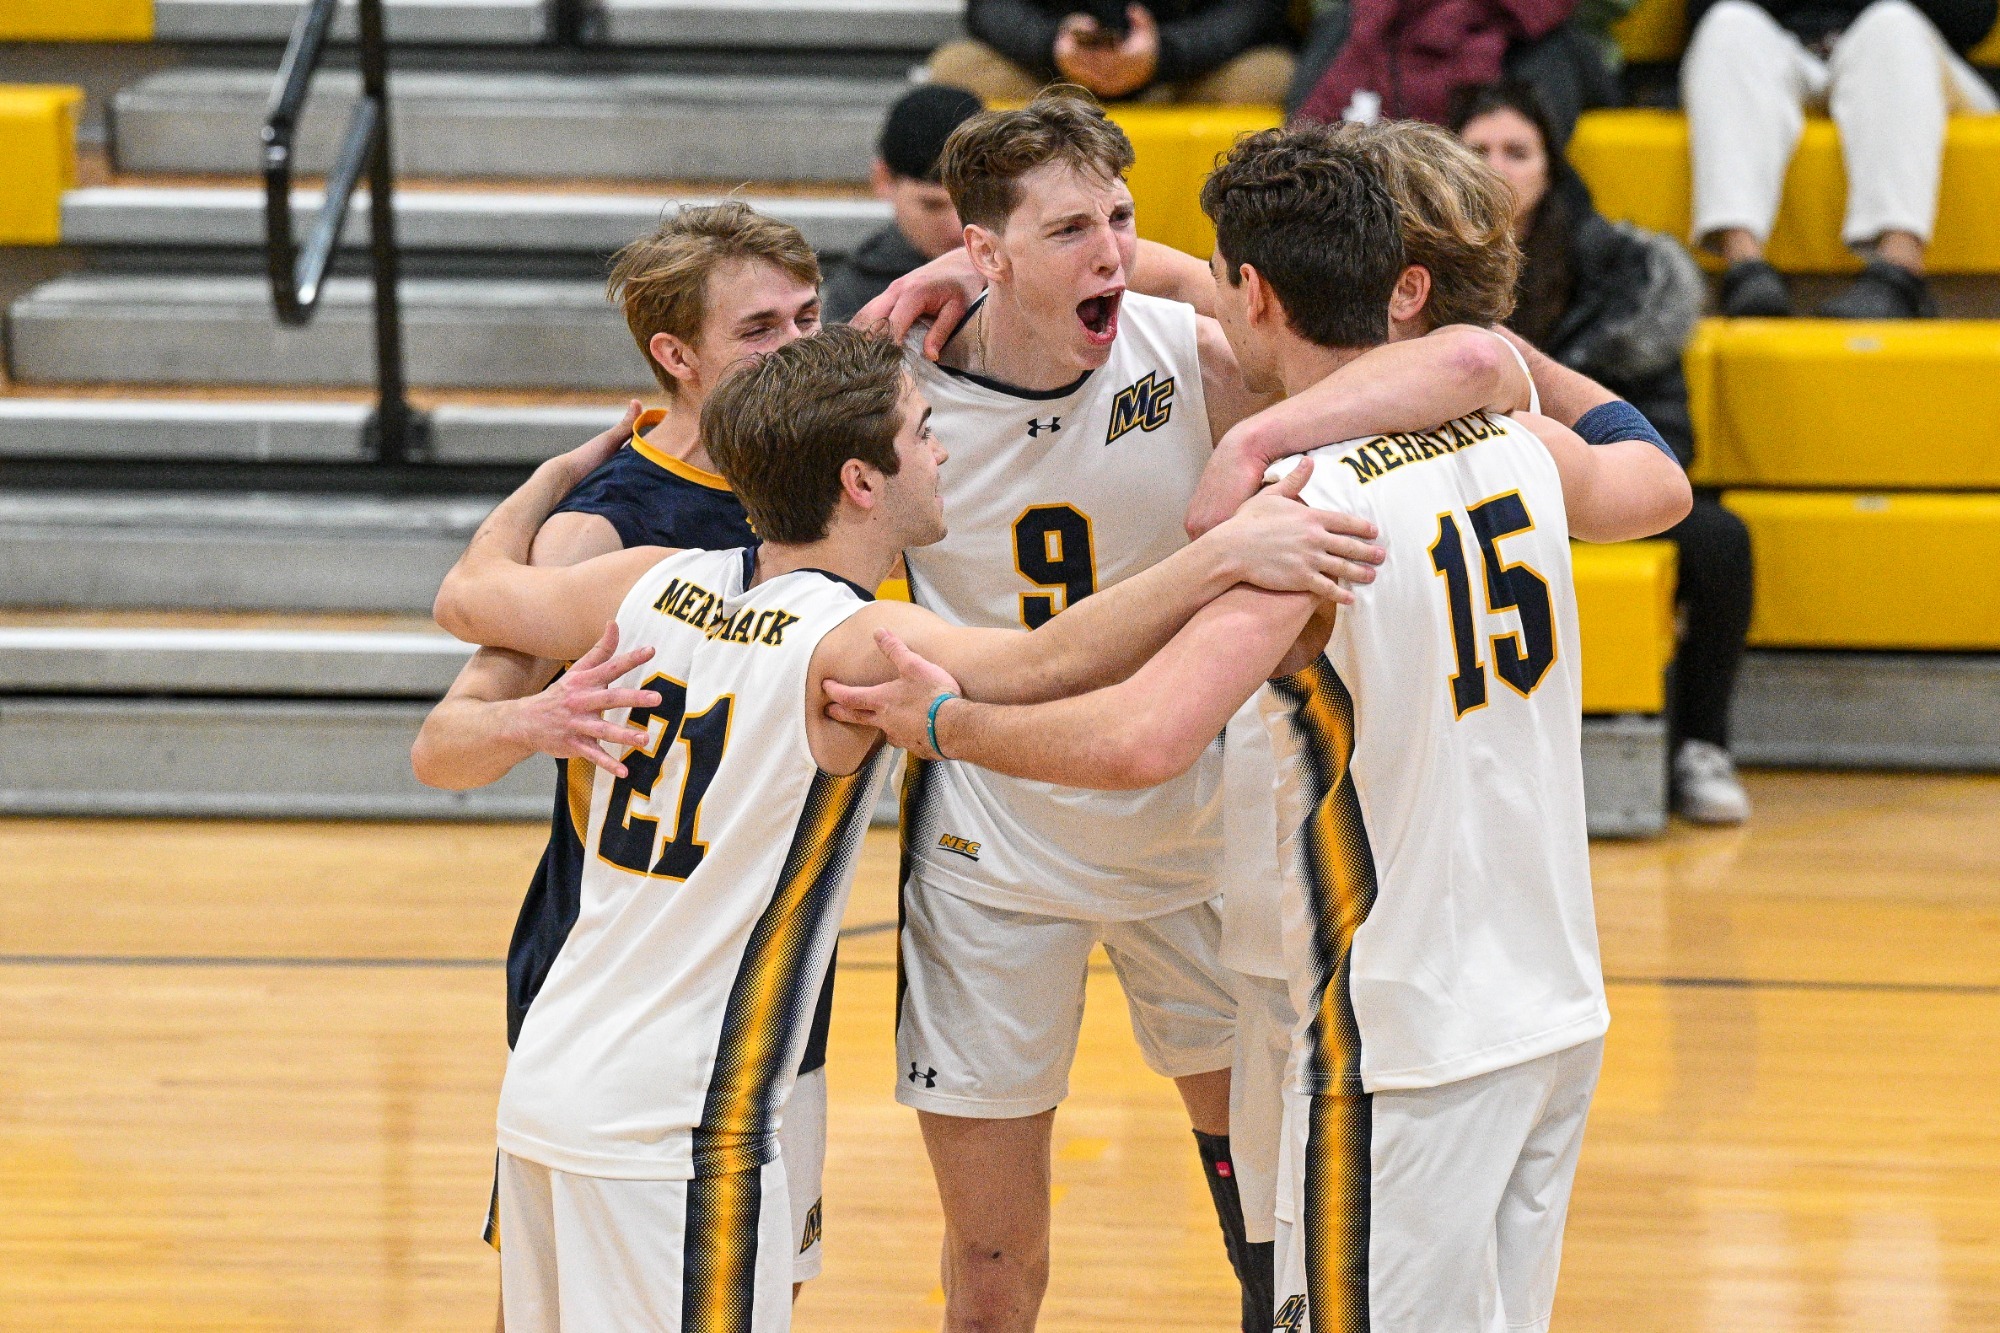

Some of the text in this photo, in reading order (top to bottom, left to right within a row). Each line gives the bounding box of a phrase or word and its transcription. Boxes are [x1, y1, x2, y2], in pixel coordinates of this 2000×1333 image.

[1105, 370, 1175, 446] MC
[1011, 502, 1098, 633] 9
[1426, 488, 1558, 722] 15
[597, 671, 736, 883] 21
[938, 833, 981, 855] NEC
